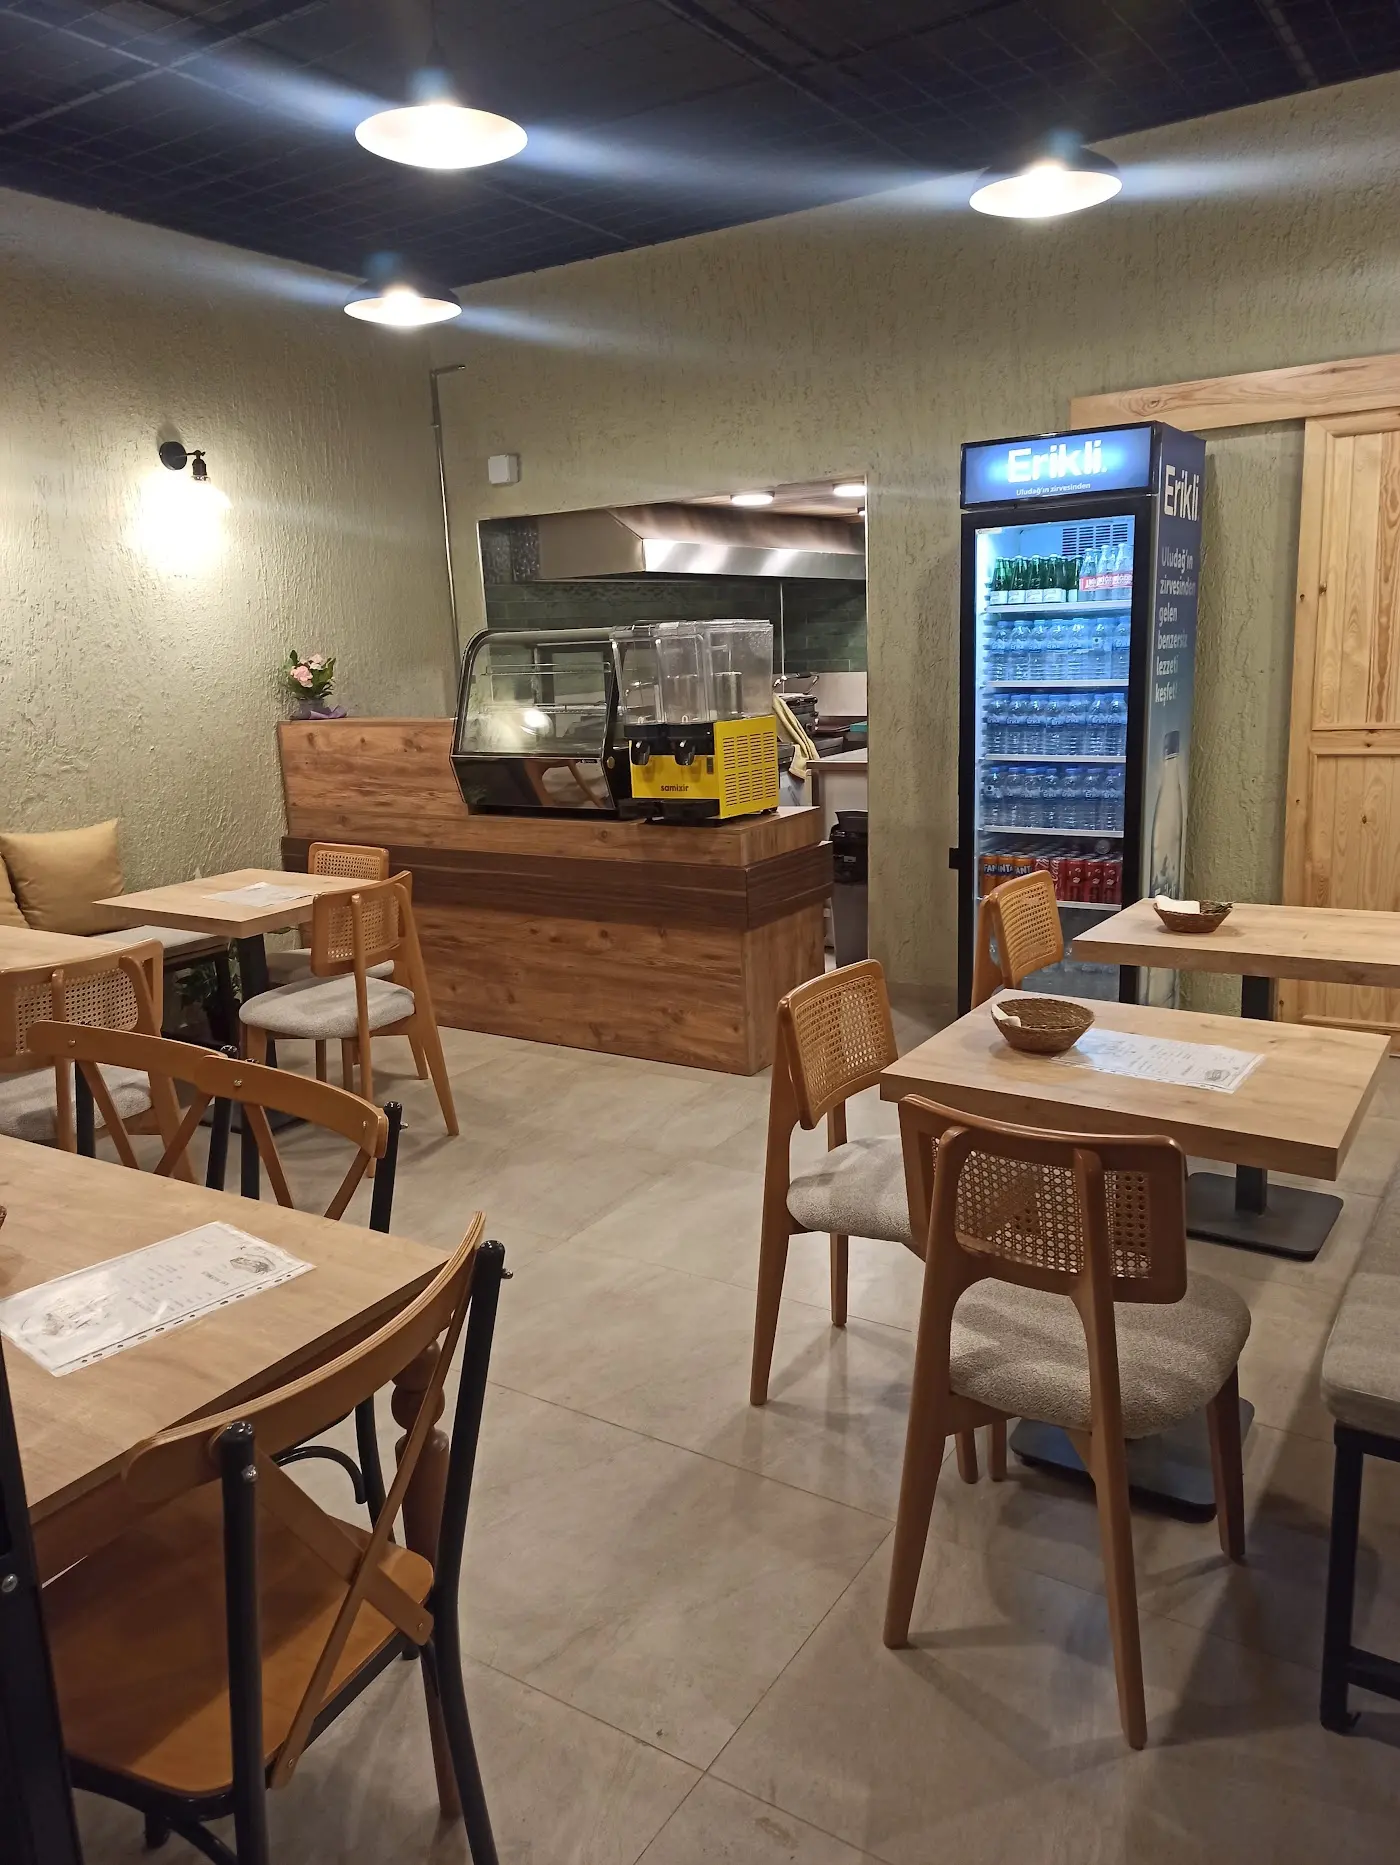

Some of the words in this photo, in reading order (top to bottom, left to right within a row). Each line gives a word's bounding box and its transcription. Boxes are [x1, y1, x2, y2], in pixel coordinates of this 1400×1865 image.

[1007, 439, 1103, 484] Erikli
[1164, 464, 1199, 521] Erikli
[1159, 575, 1196, 596] zirvesinden
[1158, 602, 1178, 626] gelen
[1157, 629, 1188, 650] benzersiz
[660, 784, 689, 792] samixir
